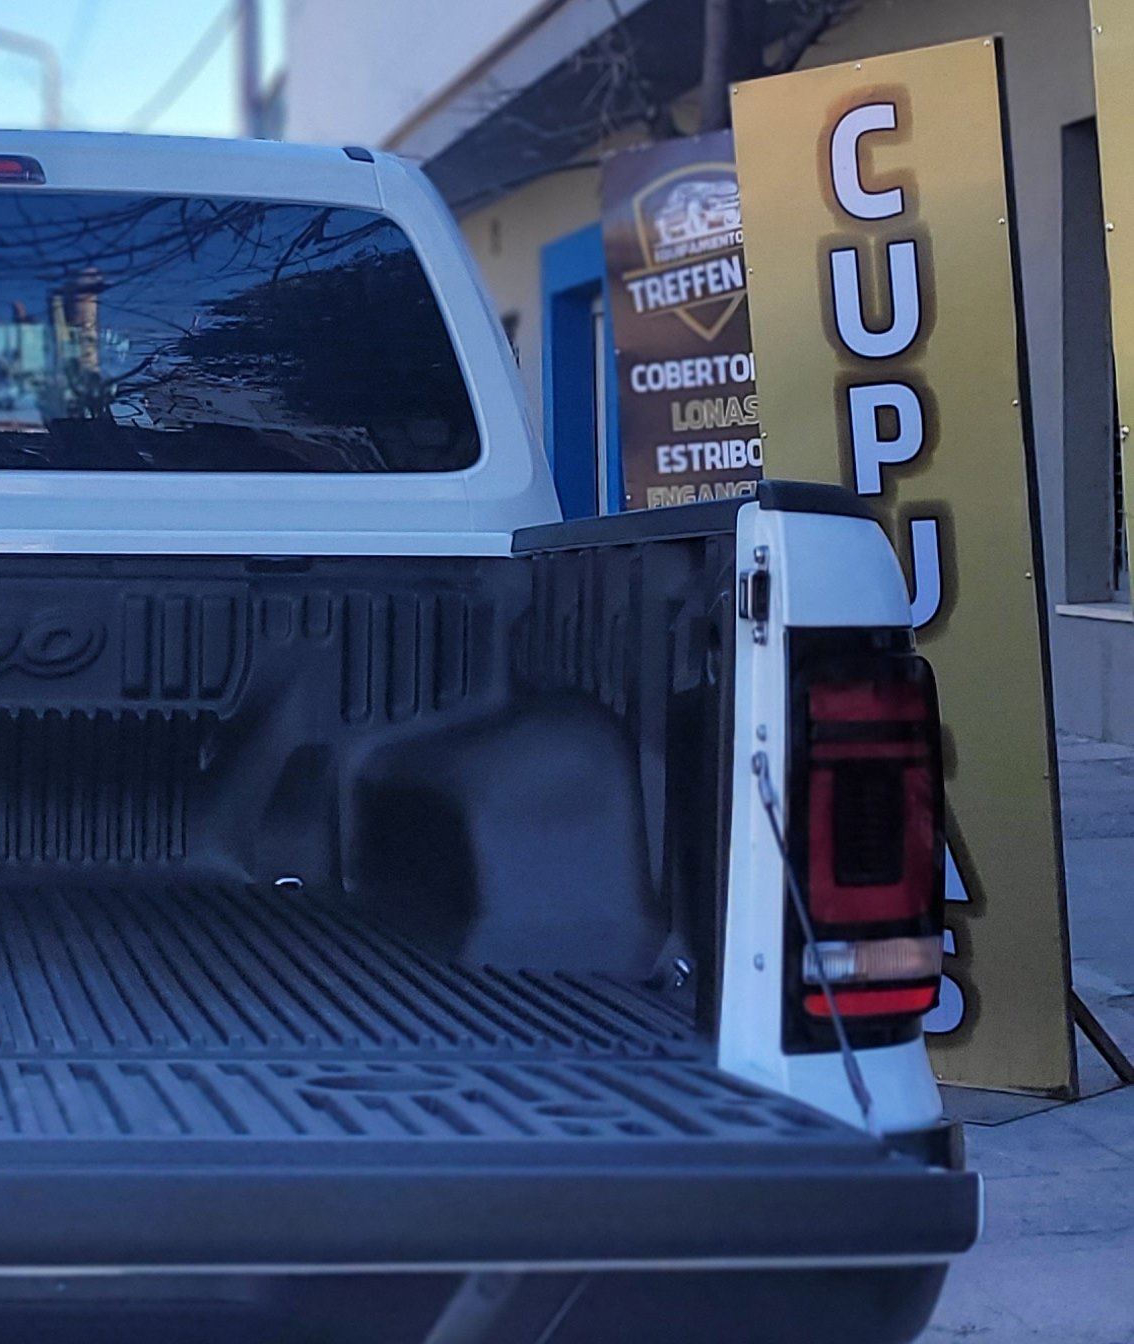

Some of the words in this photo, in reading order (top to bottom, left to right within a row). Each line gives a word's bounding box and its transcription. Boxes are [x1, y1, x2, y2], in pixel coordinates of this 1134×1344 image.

[627, 254, 744, 314] TREFFEN
[630, 353, 755, 393] COBERTO
[646, 479, 758, 509] ENGANC
